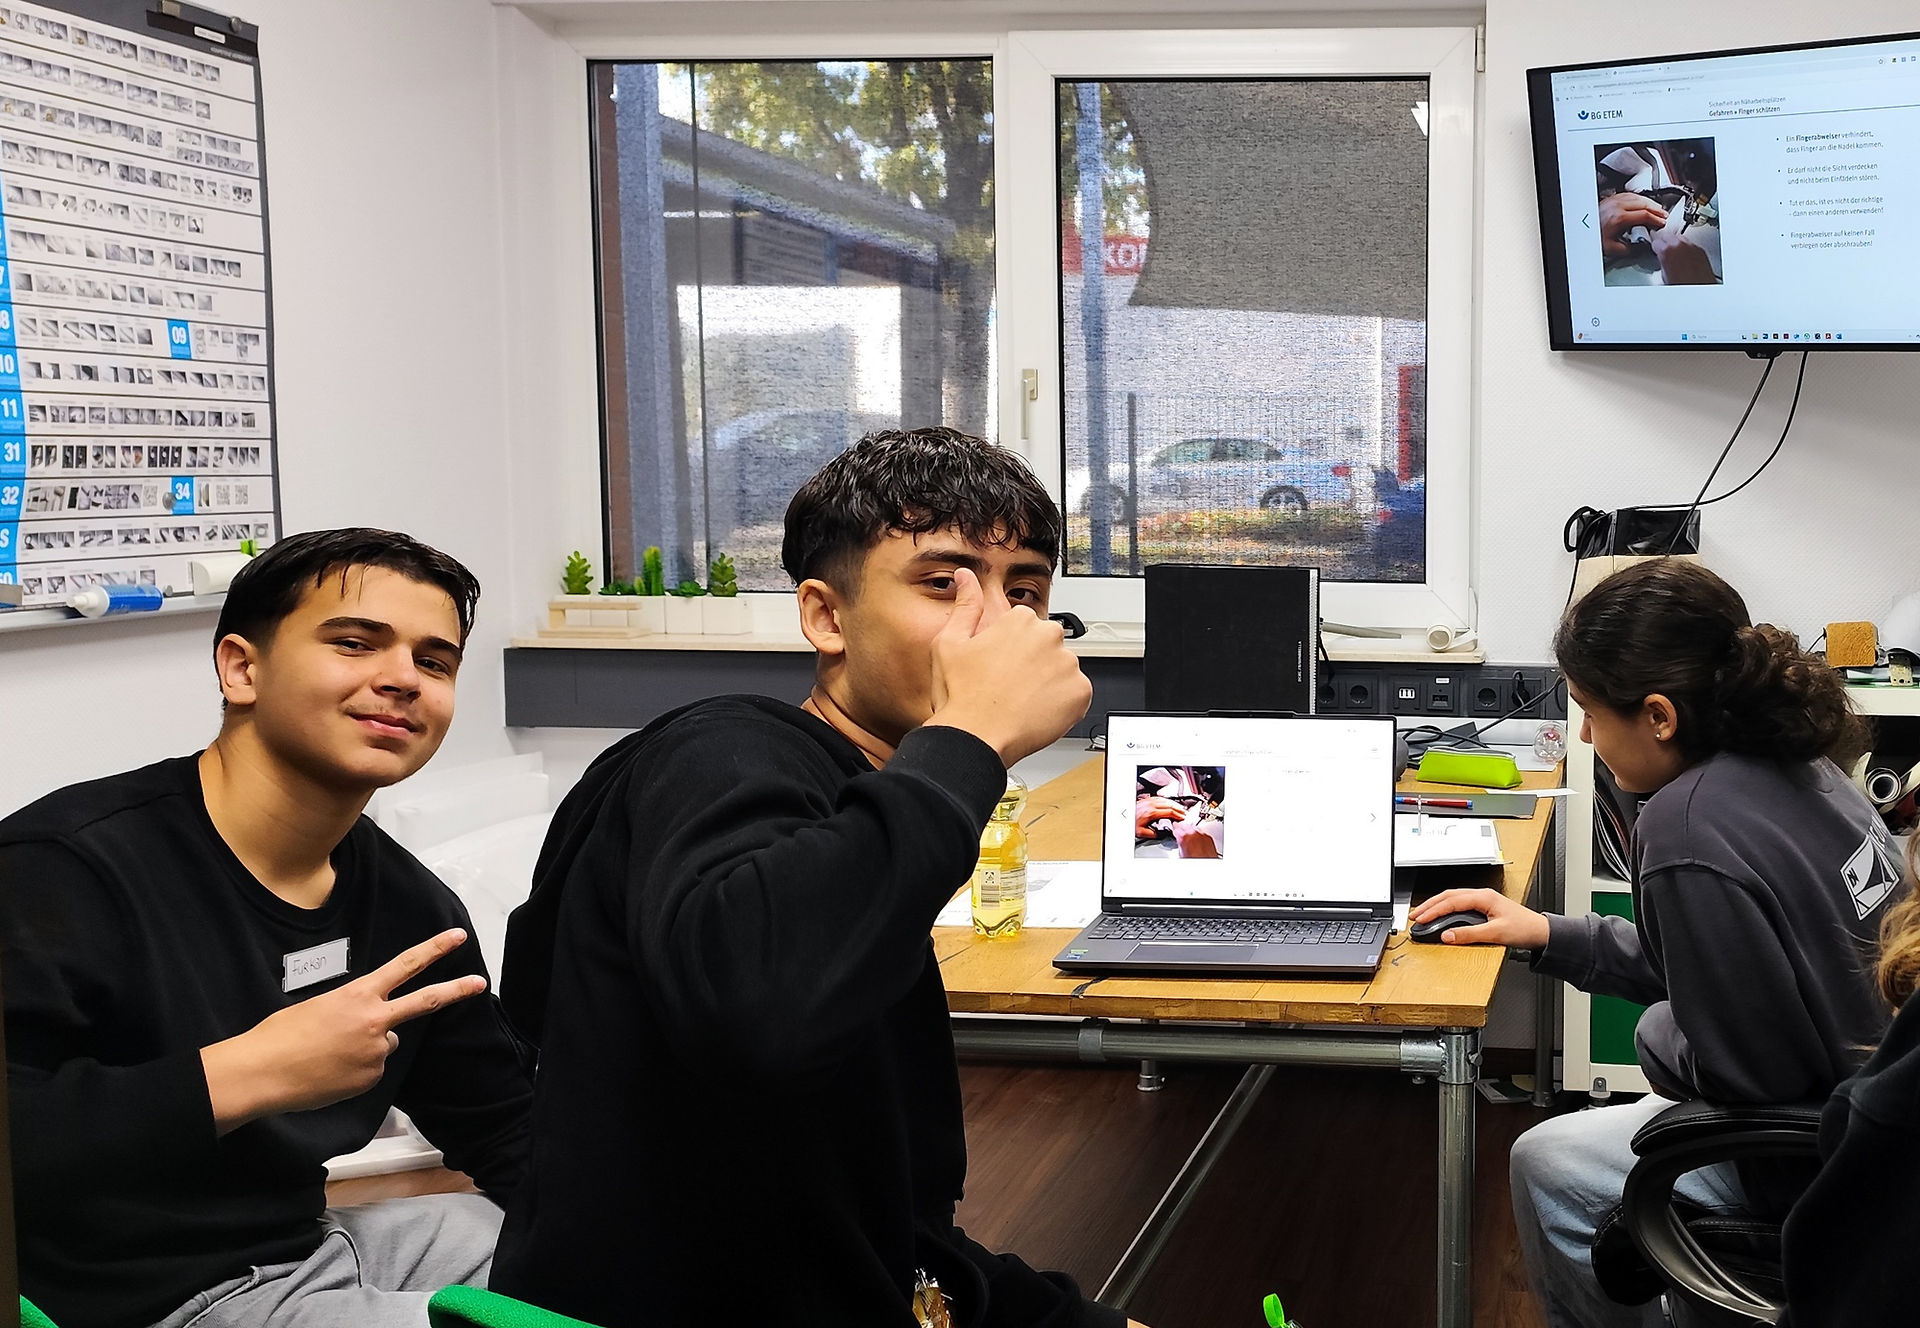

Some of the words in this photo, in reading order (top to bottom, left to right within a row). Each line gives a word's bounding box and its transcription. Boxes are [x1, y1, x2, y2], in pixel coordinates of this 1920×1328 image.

[1590, 111, 1602, 120] BG
[1603, 109, 1624, 119] ETEM
[1755, 106, 1781, 114] schützen
[1795, 133, 1841, 142] Fingerabweiser
[1786, 146, 1800, 154] dass
[1827, 143, 1837, 151] die
[1847, 163, 1878, 171] verdecken
[1790, 231, 1833, 240] Fingerabweiser
[1833, 229, 1844, 237] auf
[1844, 229, 1864, 237] keinen
[171, 325, 187, 345] 09
[0, 354, 15, 374] 10
[1, 397, 18, 418] 11
[4, 442, 20, 462] 31
[2, 486, 20, 506] 32
[175, 482, 190, 501] 34
